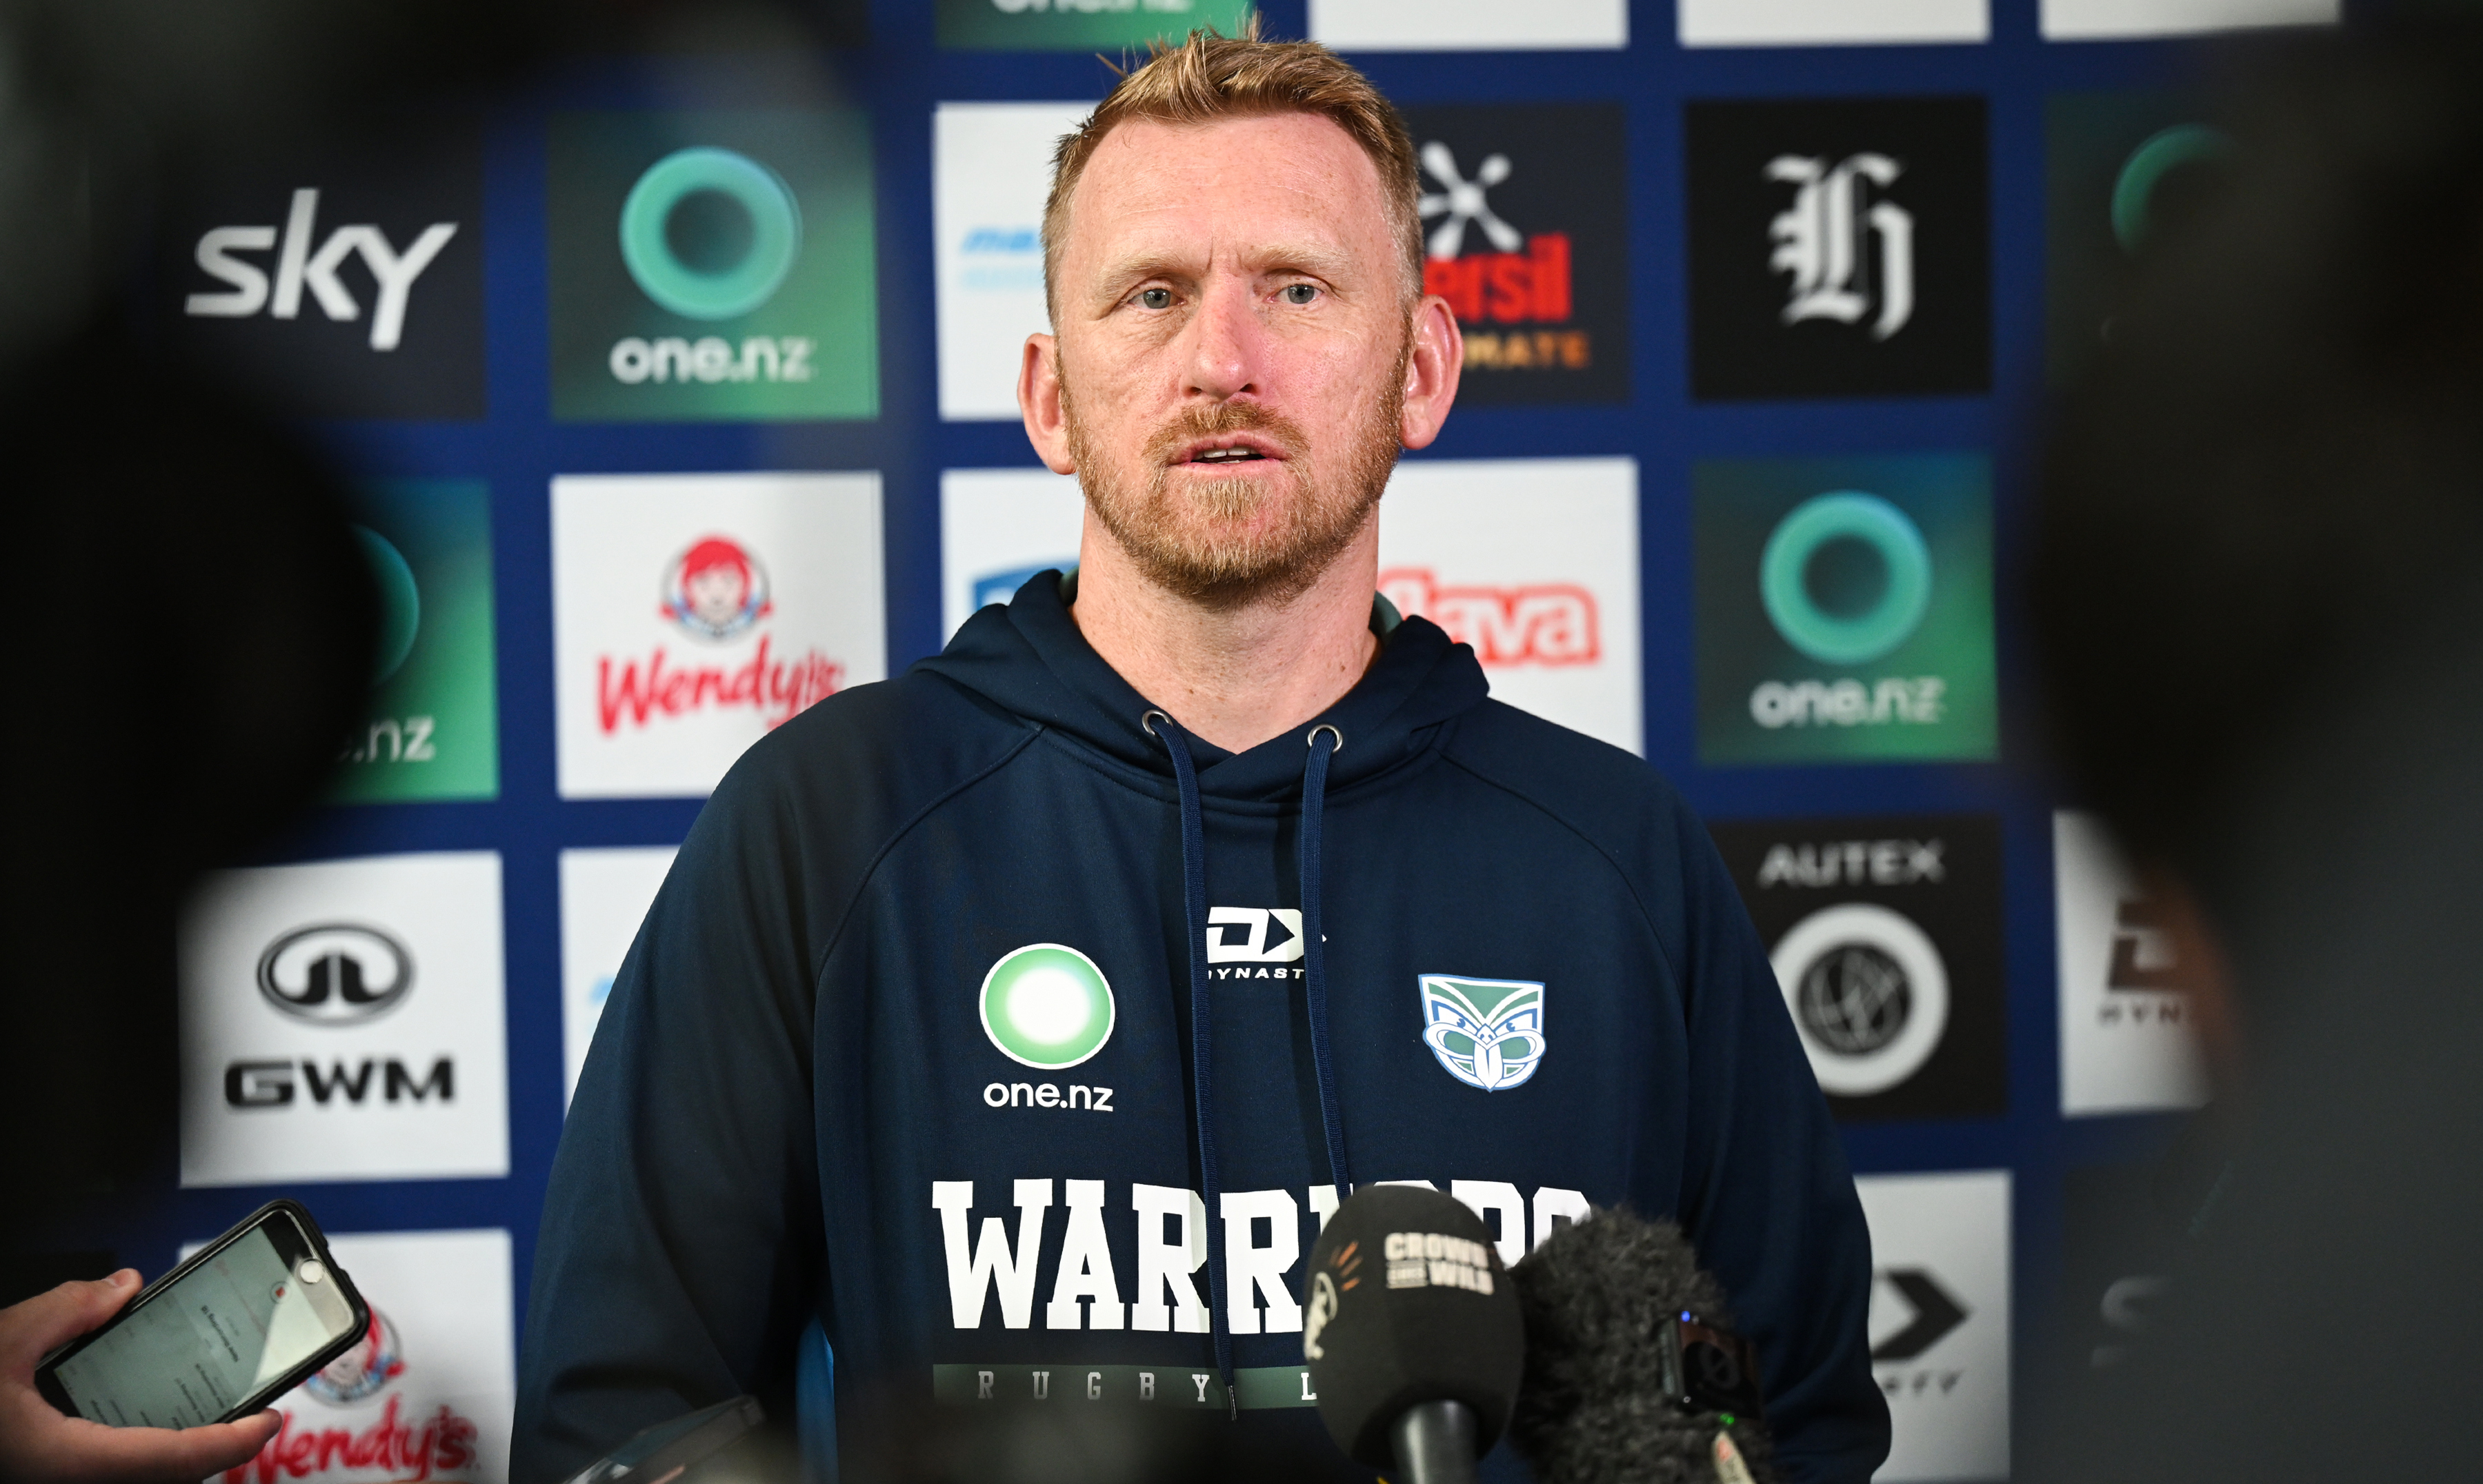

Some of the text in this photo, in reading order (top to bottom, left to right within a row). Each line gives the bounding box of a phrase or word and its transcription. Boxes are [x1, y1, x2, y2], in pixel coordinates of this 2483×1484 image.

[1424, 231, 1573, 323] ersil
[609, 337, 817, 384] one.nz
[1463, 331, 1590, 369] MATE
[1750, 676, 1946, 727] one.nz
[1758, 837, 1946, 888] AUTEX
[1208, 967, 1304, 979] YNAST
[224, 1056, 457, 1109] GWM
[984, 1082, 1113, 1112] one.nz
[978, 1371, 1209, 1402] RUGBY
